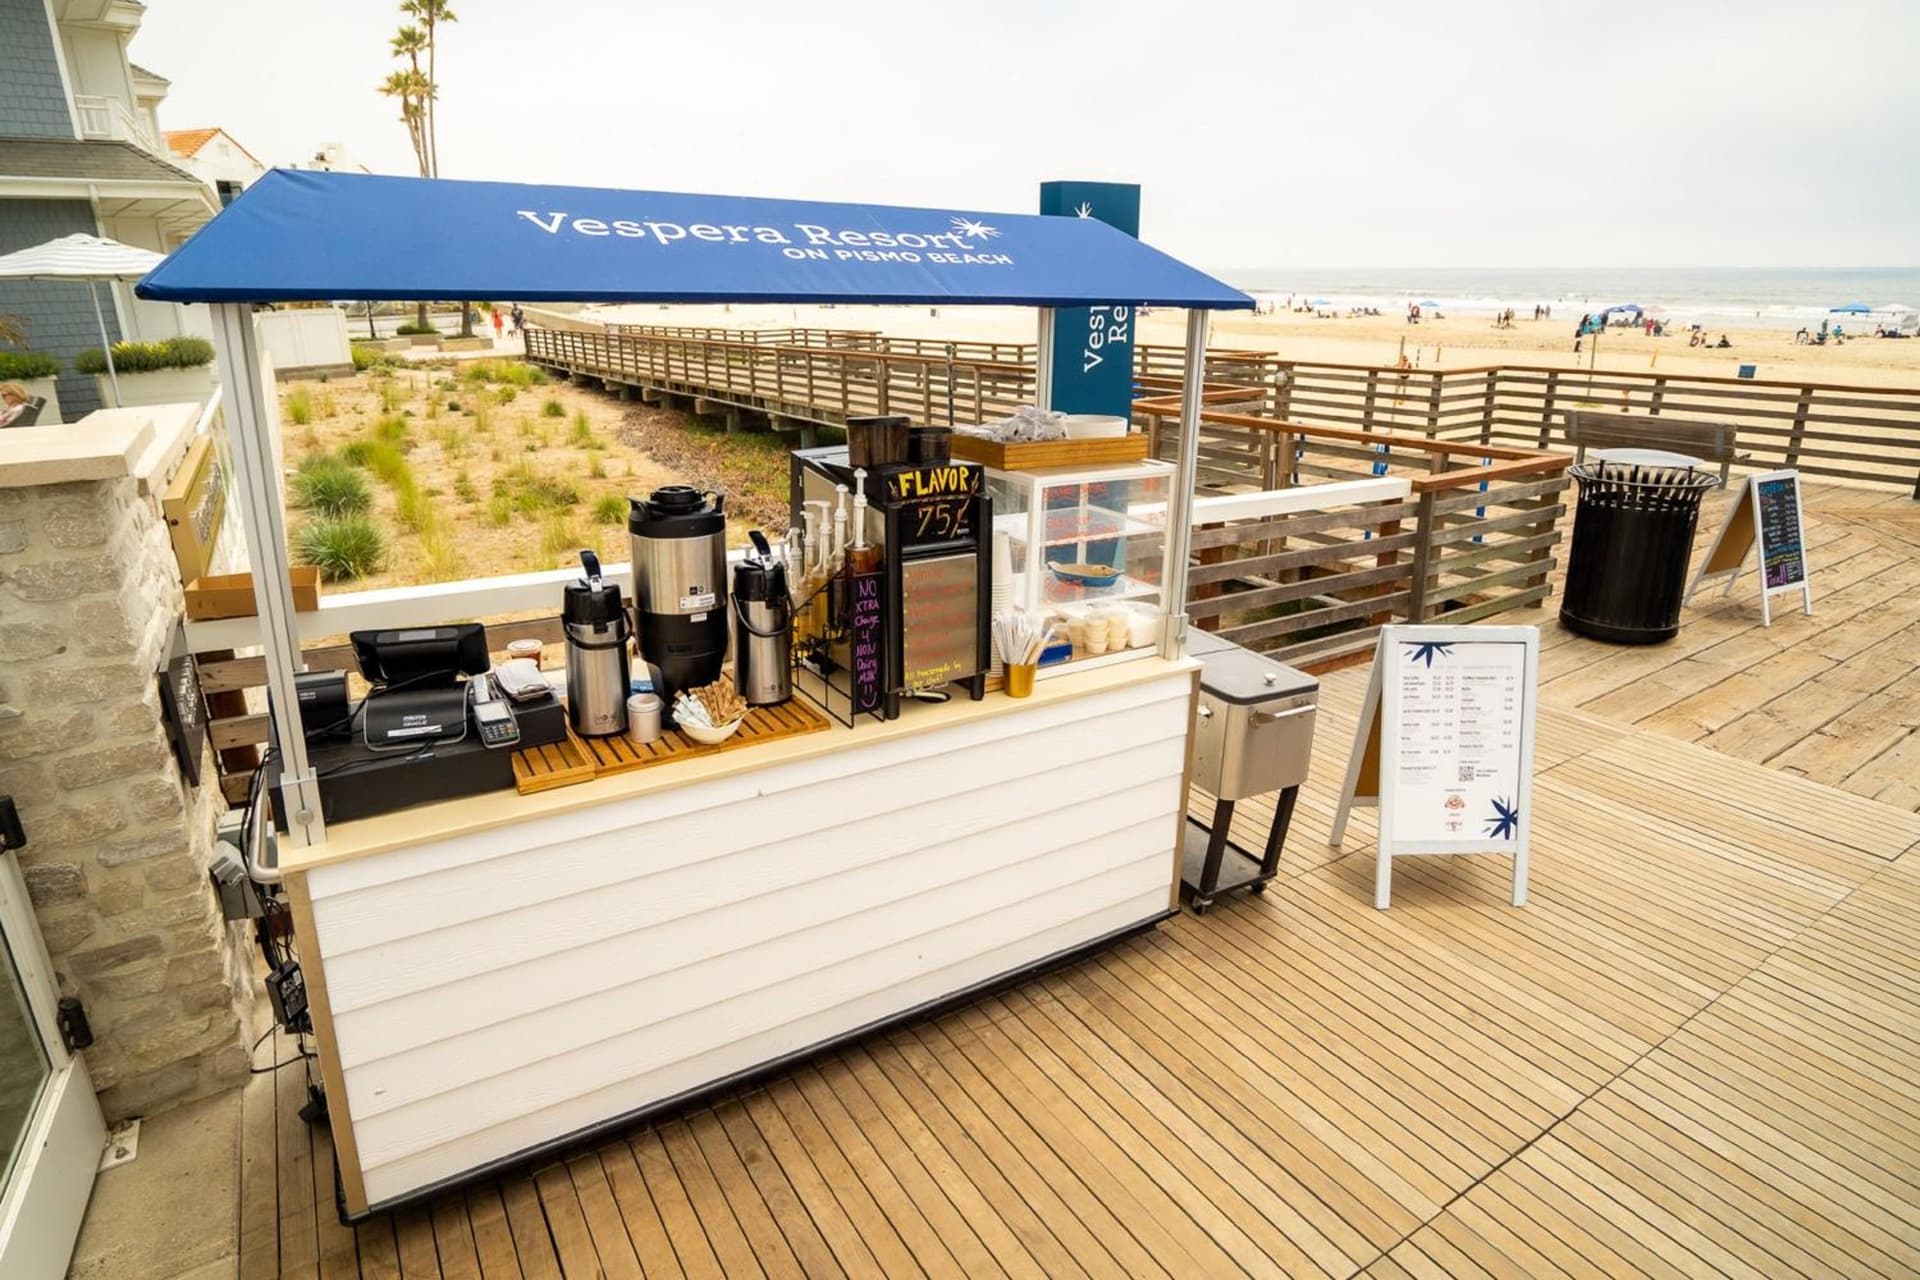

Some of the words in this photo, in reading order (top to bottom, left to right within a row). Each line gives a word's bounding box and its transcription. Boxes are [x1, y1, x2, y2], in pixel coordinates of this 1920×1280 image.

[516, 210, 791, 245] Vespera
[794, 223, 974, 250] Resort
[782, 248, 829, 260] ON
[833, 249, 921, 263] PISMO
[927, 252, 1014, 265] BEACH
[898, 466, 970, 497] FLAVOR
[858, 578, 877, 598] NO
[861, 629, 870, 642] 4
